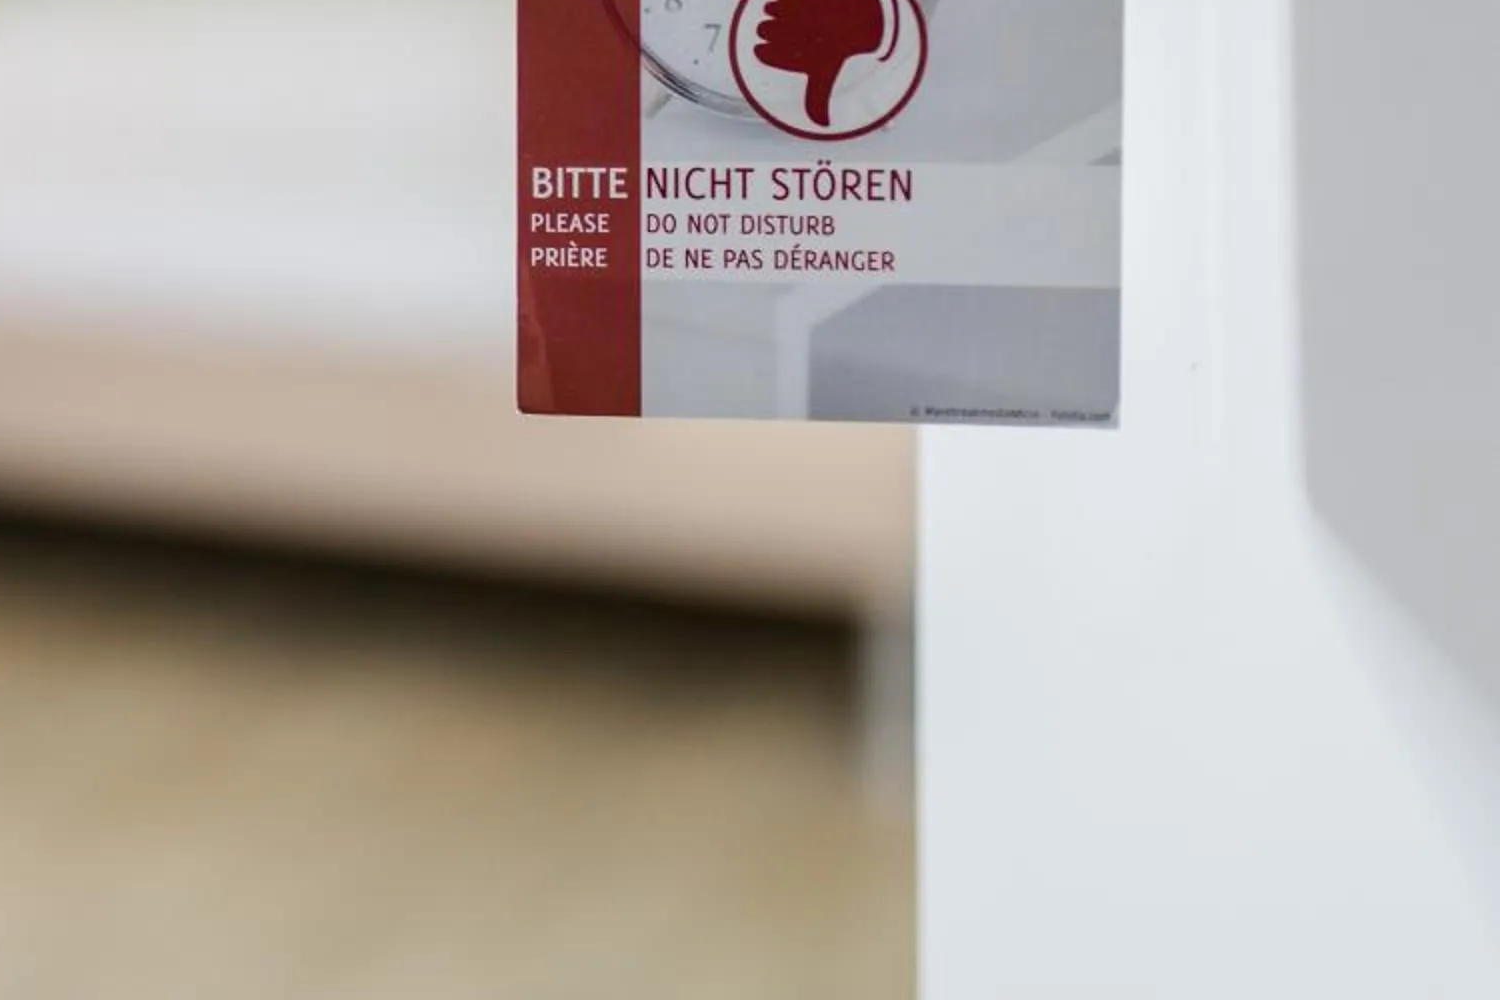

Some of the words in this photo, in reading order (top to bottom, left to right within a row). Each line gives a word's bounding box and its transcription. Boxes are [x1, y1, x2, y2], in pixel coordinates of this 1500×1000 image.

[704, 23, 722, 52] 7
[531, 167, 629, 200] BITTE
[646, 167, 755, 201] NICHT
[771, 160, 913, 202] STÖREN
[531, 213, 610, 234] PLEASE
[646, 213, 677, 234] DO
[687, 214, 731, 235] NOT
[741, 214, 836, 236] DISTURB
[531, 242, 608, 268] PRIÈRE
[646, 248, 674, 269] DE
[684, 248, 713, 270] NE
[723, 249, 763, 270] PAS
[773, 243, 895, 272] DÉRANGER
